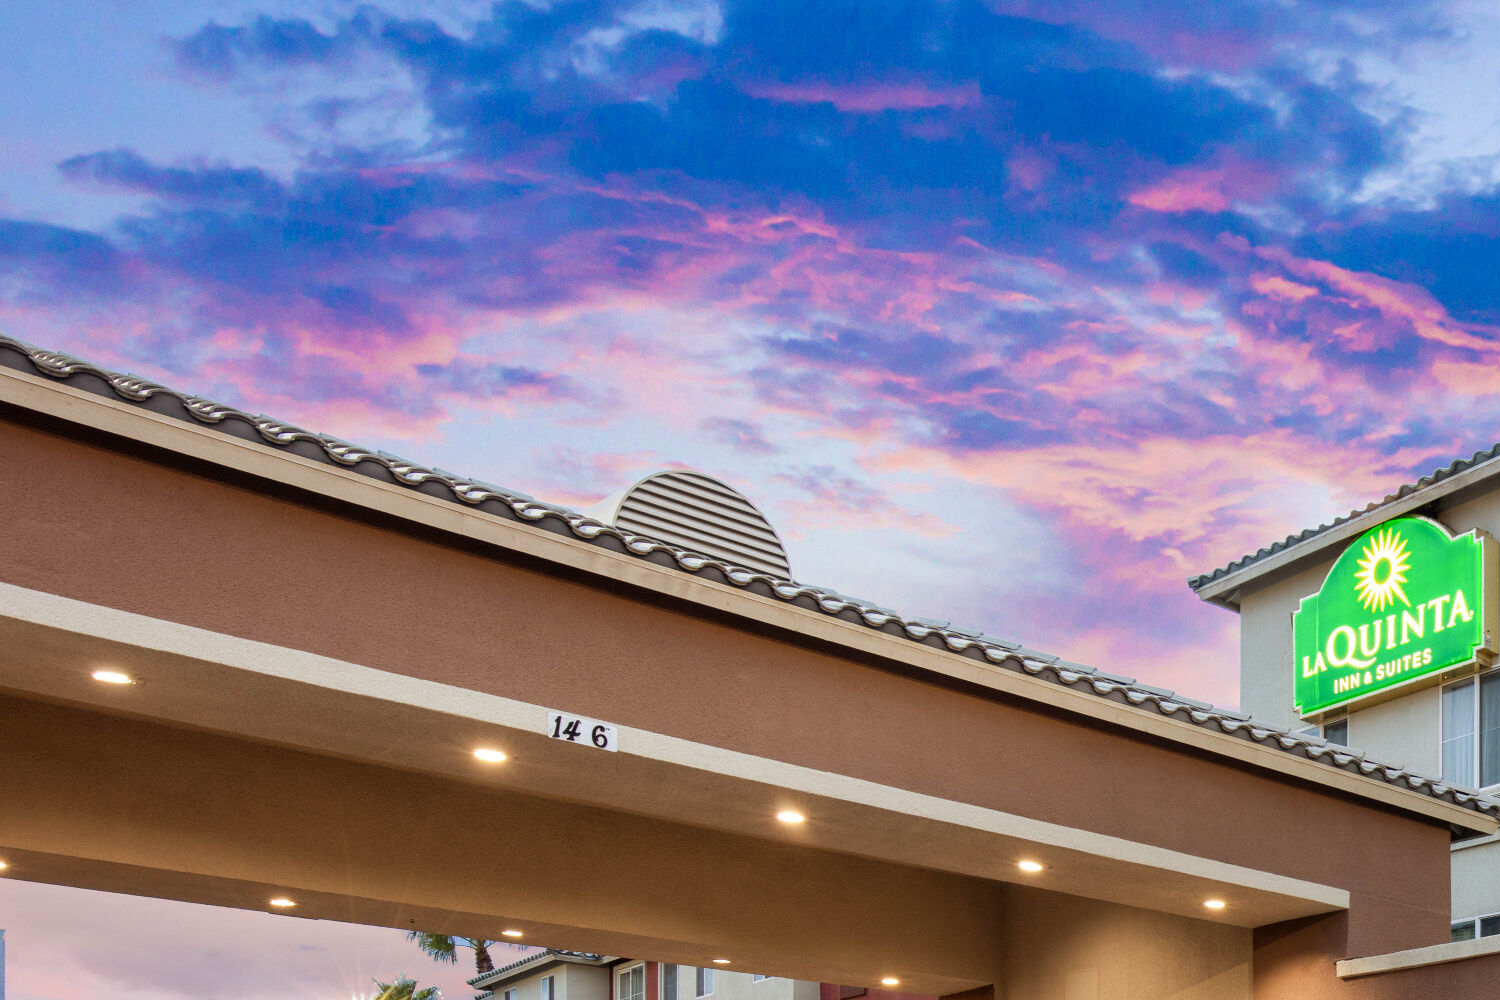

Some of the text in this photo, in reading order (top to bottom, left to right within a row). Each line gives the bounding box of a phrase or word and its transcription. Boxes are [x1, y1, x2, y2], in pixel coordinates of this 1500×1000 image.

[1303, 590, 1473, 678] LA QUINTA
[1334, 648, 1432, 694] INN & SUITES
